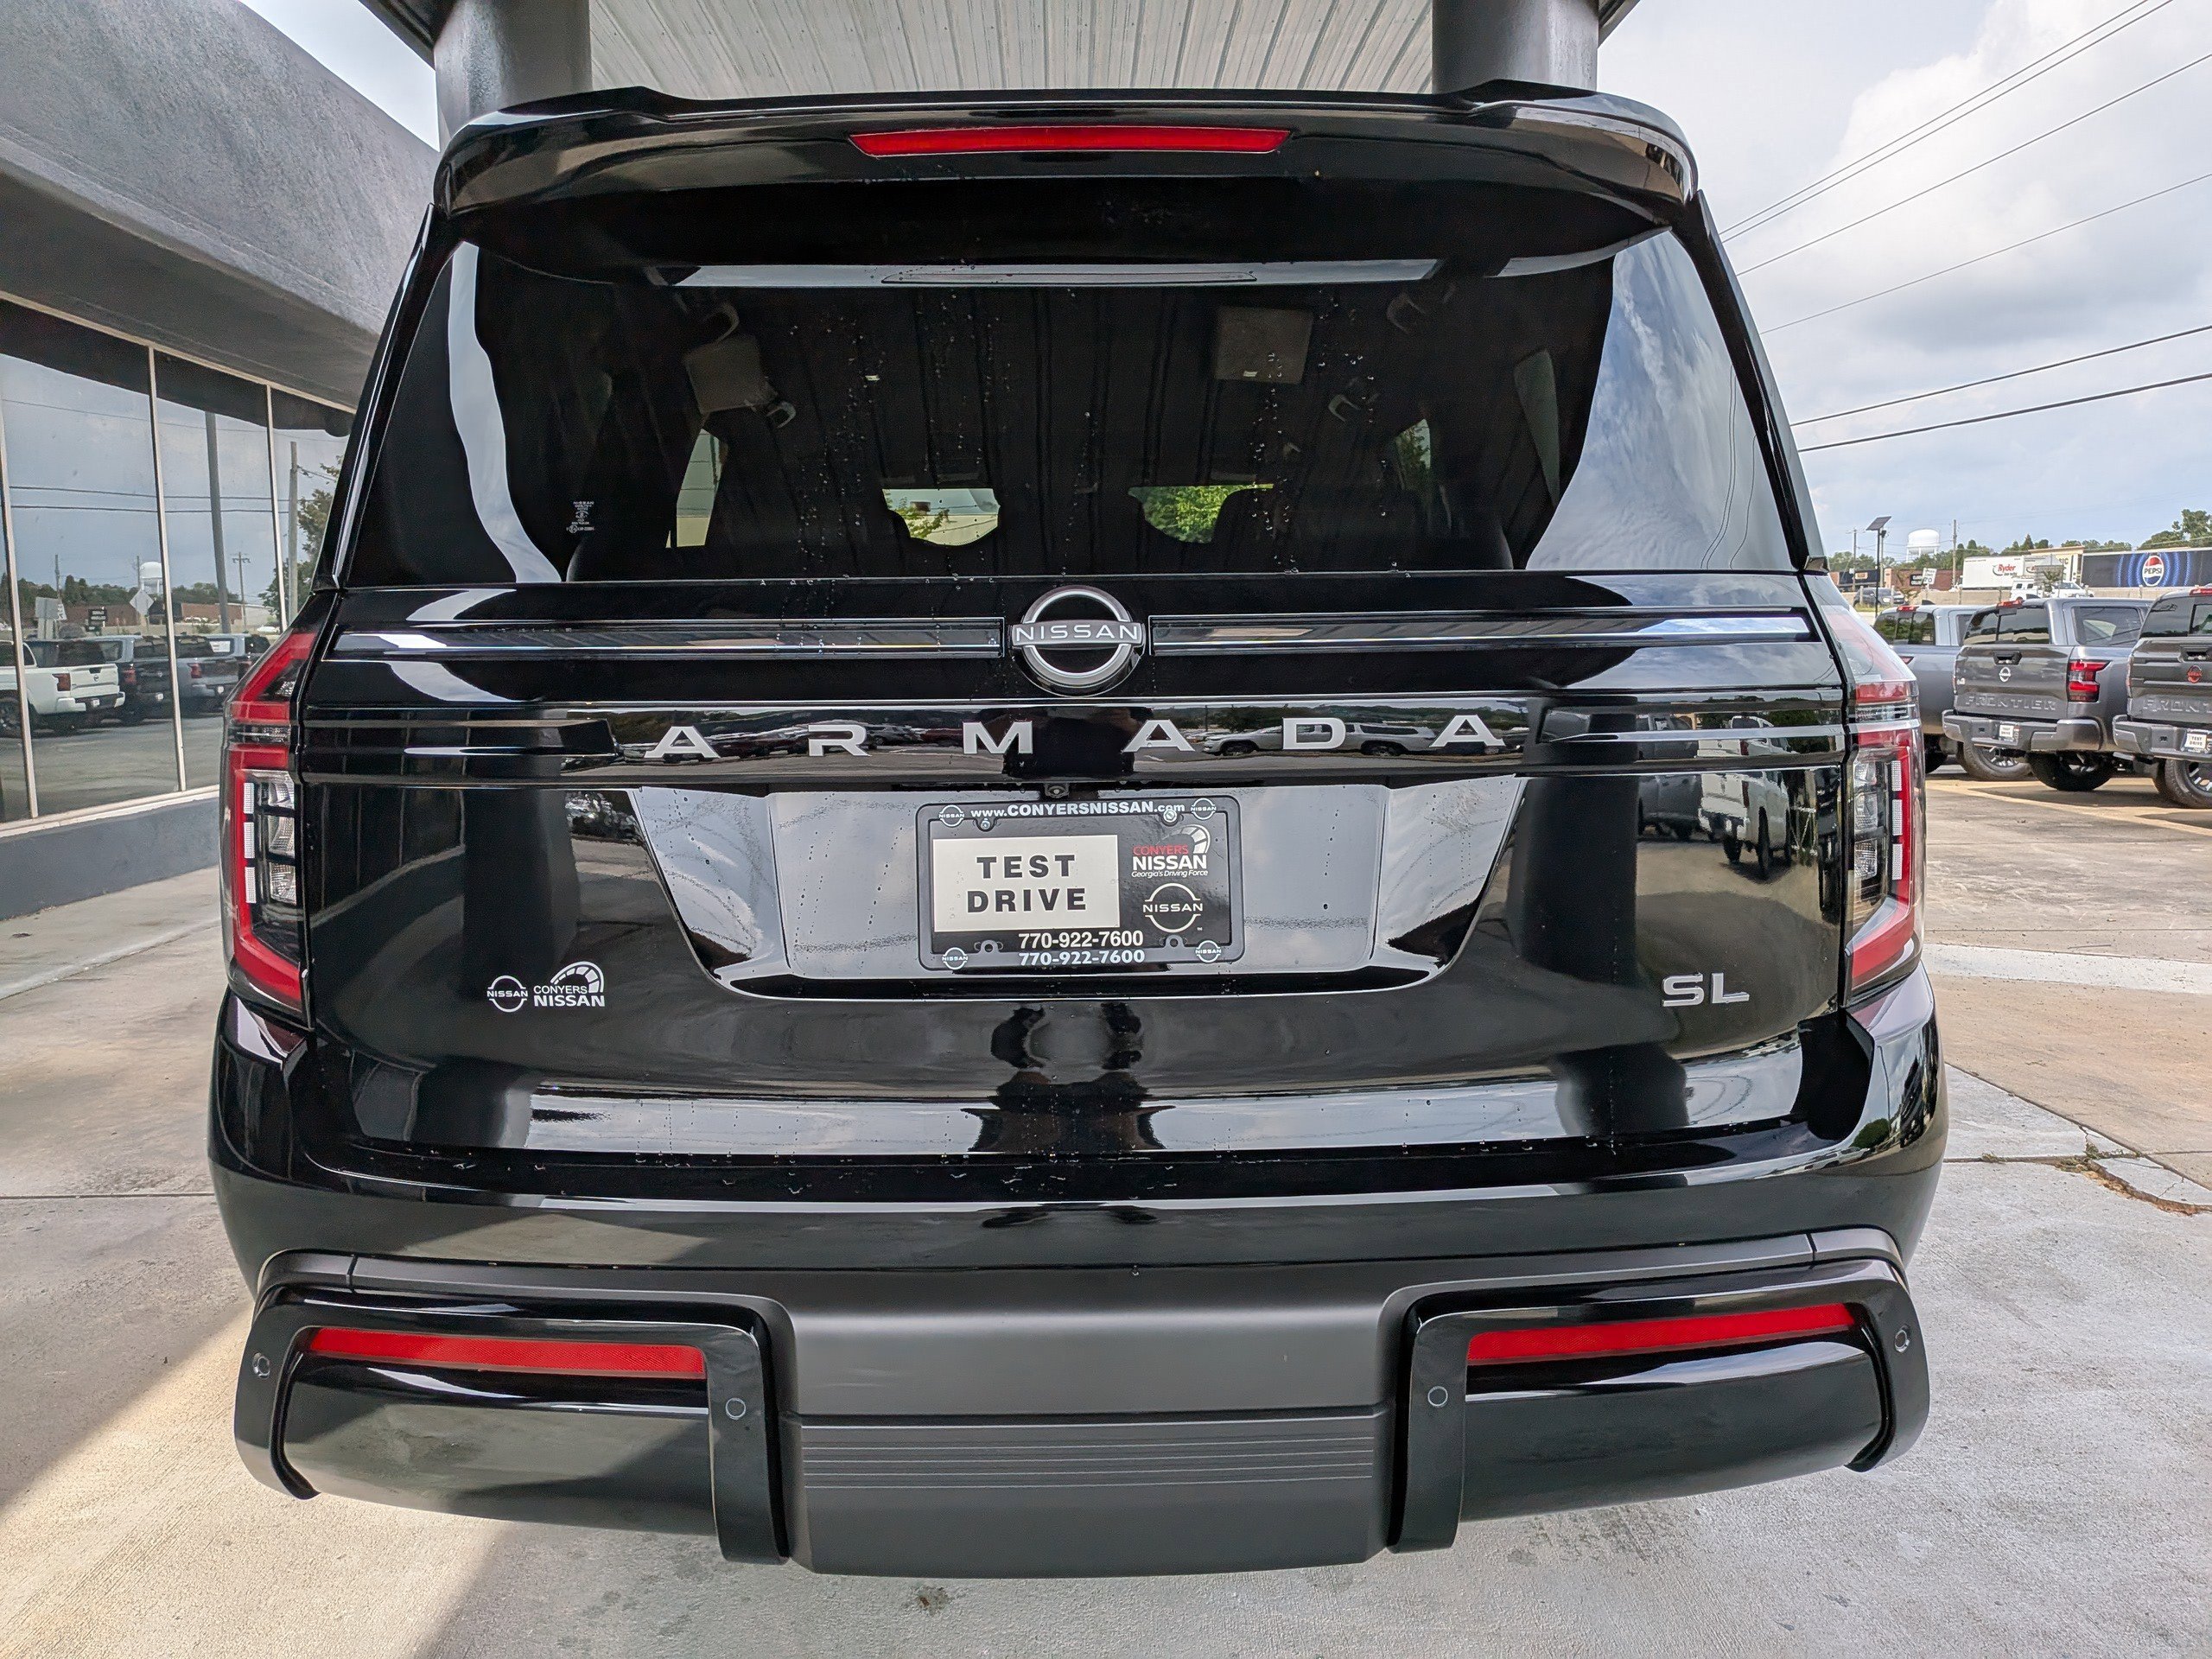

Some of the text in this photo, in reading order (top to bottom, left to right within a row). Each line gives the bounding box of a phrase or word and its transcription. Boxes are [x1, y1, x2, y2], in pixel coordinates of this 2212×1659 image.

[1998, 563, 2016, 573] Ryder
[1015, 623, 1138, 642] NISSAN
[644, 714, 1506, 760] ARMADA
[1133, 845, 1189, 856] CONYERS
[976, 855, 1076, 880] TEST
[1132, 855, 1207, 871] NISSAN
[1131, 870, 1163, 879] Georgia's
[1164, 869, 1187, 878] Driving
[967, 887, 1086, 913] DRIVE
[1142, 903, 1204, 912] NISSAN
[1018, 931, 1144, 950] 770-922-7600
[1018, 950, 1145, 966] 770-922-7600
[533, 985, 588, 995] CONYERS
[1662, 972, 1751, 1007] SL
[533, 995, 605, 1007] NISSAN
